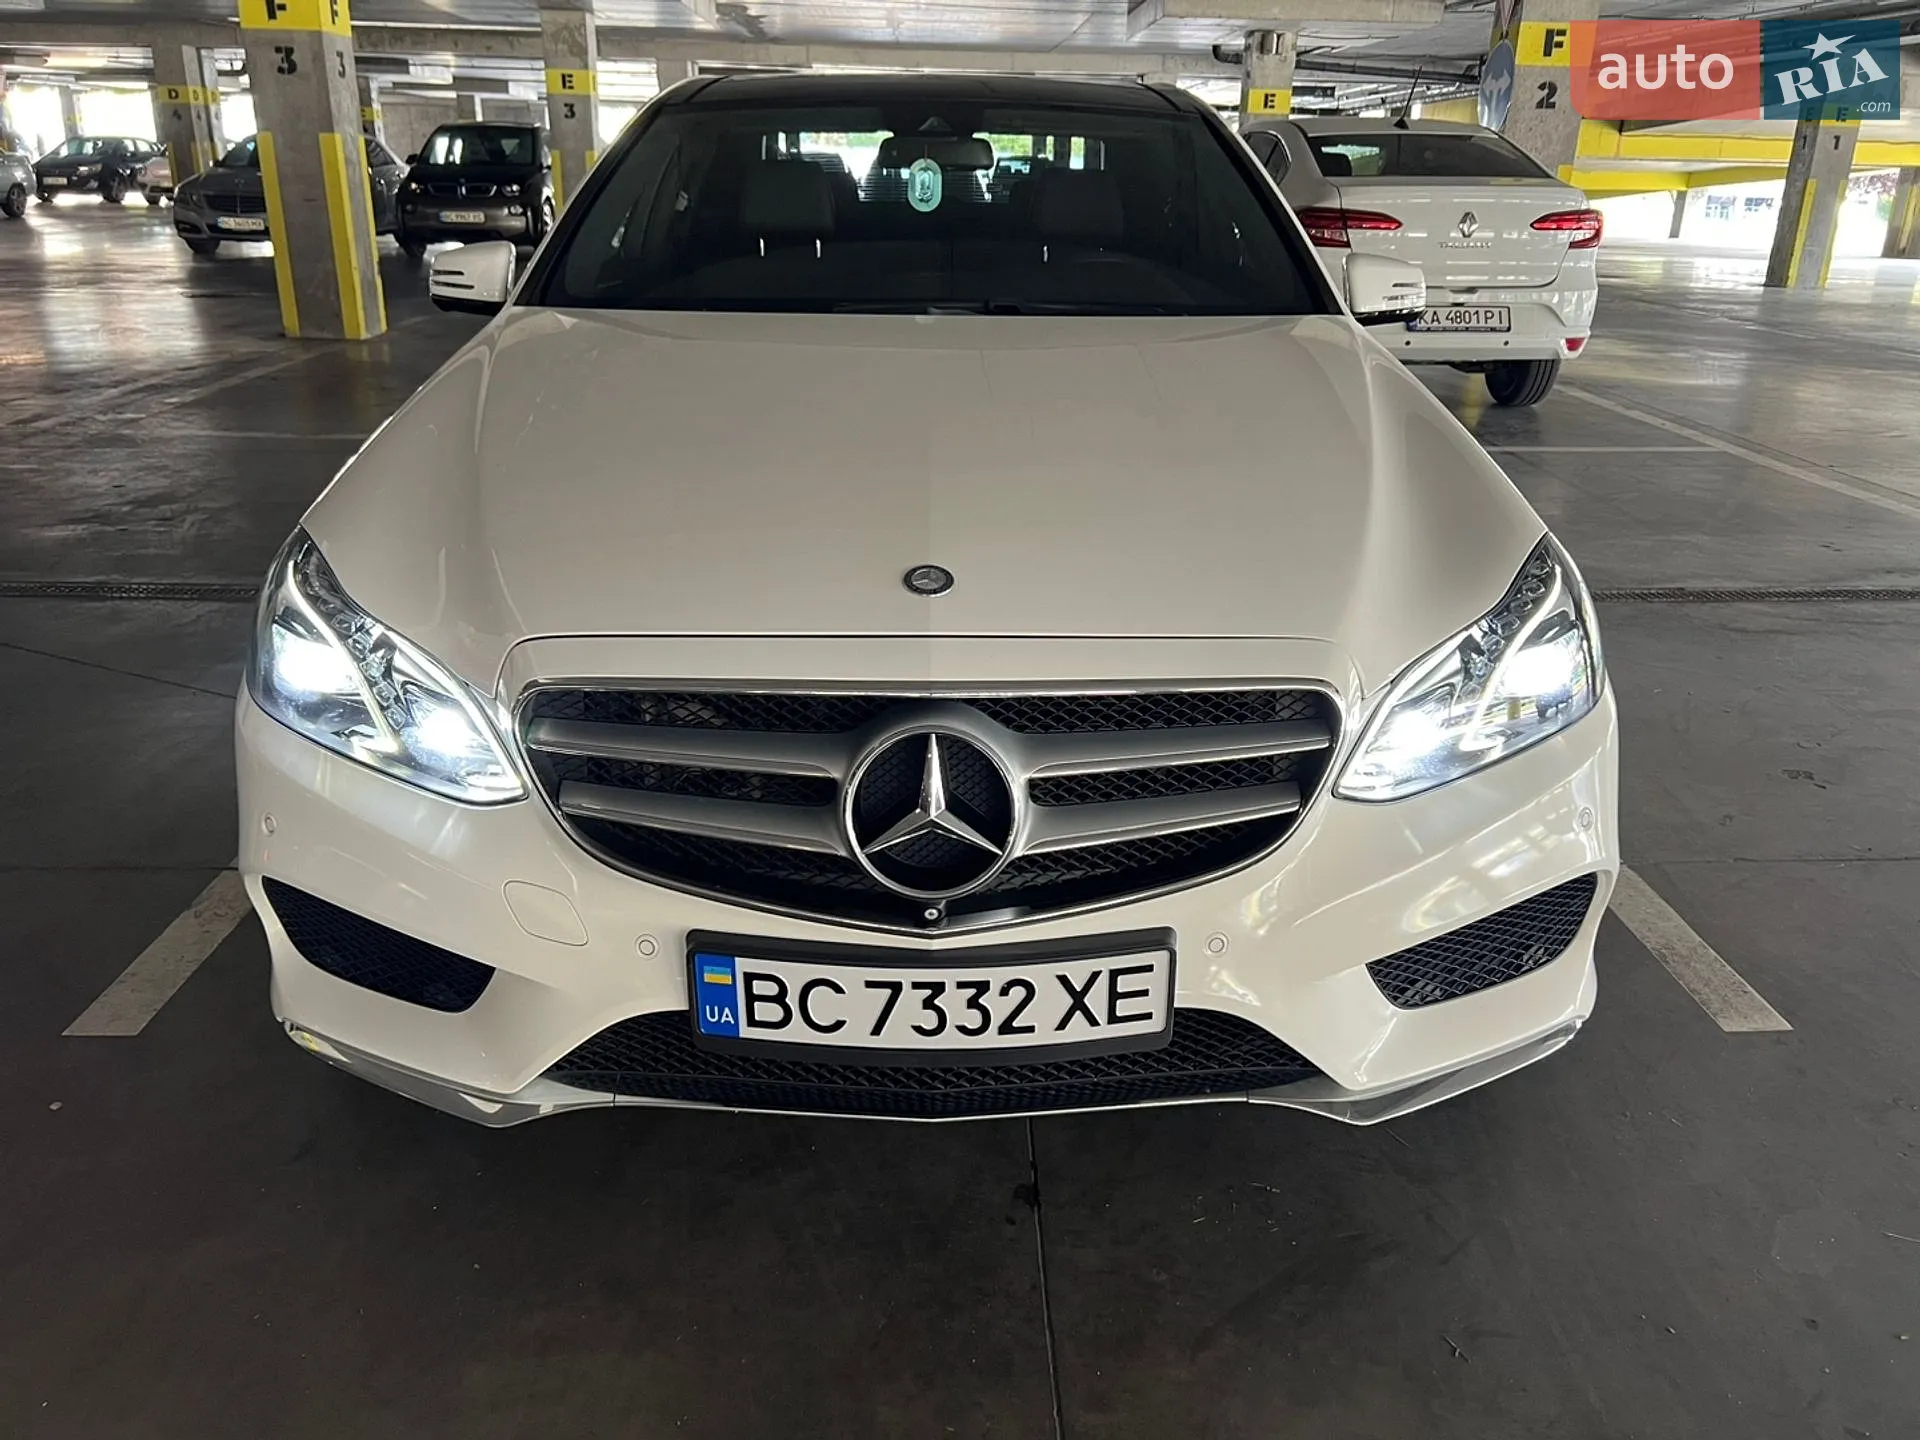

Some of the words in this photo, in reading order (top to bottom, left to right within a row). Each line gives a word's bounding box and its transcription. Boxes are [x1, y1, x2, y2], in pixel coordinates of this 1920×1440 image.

[1543, 28, 1567, 57] F
[275, 46, 297, 75] 3
[336, 50, 346, 78] 3
[561, 73, 575, 89] E
[168, 88, 179, 100] D
[1263, 93, 1277, 109] E
[1535, 81, 1558, 109] 2
[564, 102, 576, 119] 3
[1835, 106, 1848, 122] E
[1833, 135, 1841, 150] 1
[1418, 311, 1441, 325] KA
[1445, 310, 1480, 324] 4801
[1484, 310, 1503, 325] PI
[743, 971, 847, 1034] BC
[864, 978, 1036, 1038] 7332
[1053, 963, 1156, 1032] XE
[705, 1005, 735, 1026] UA
